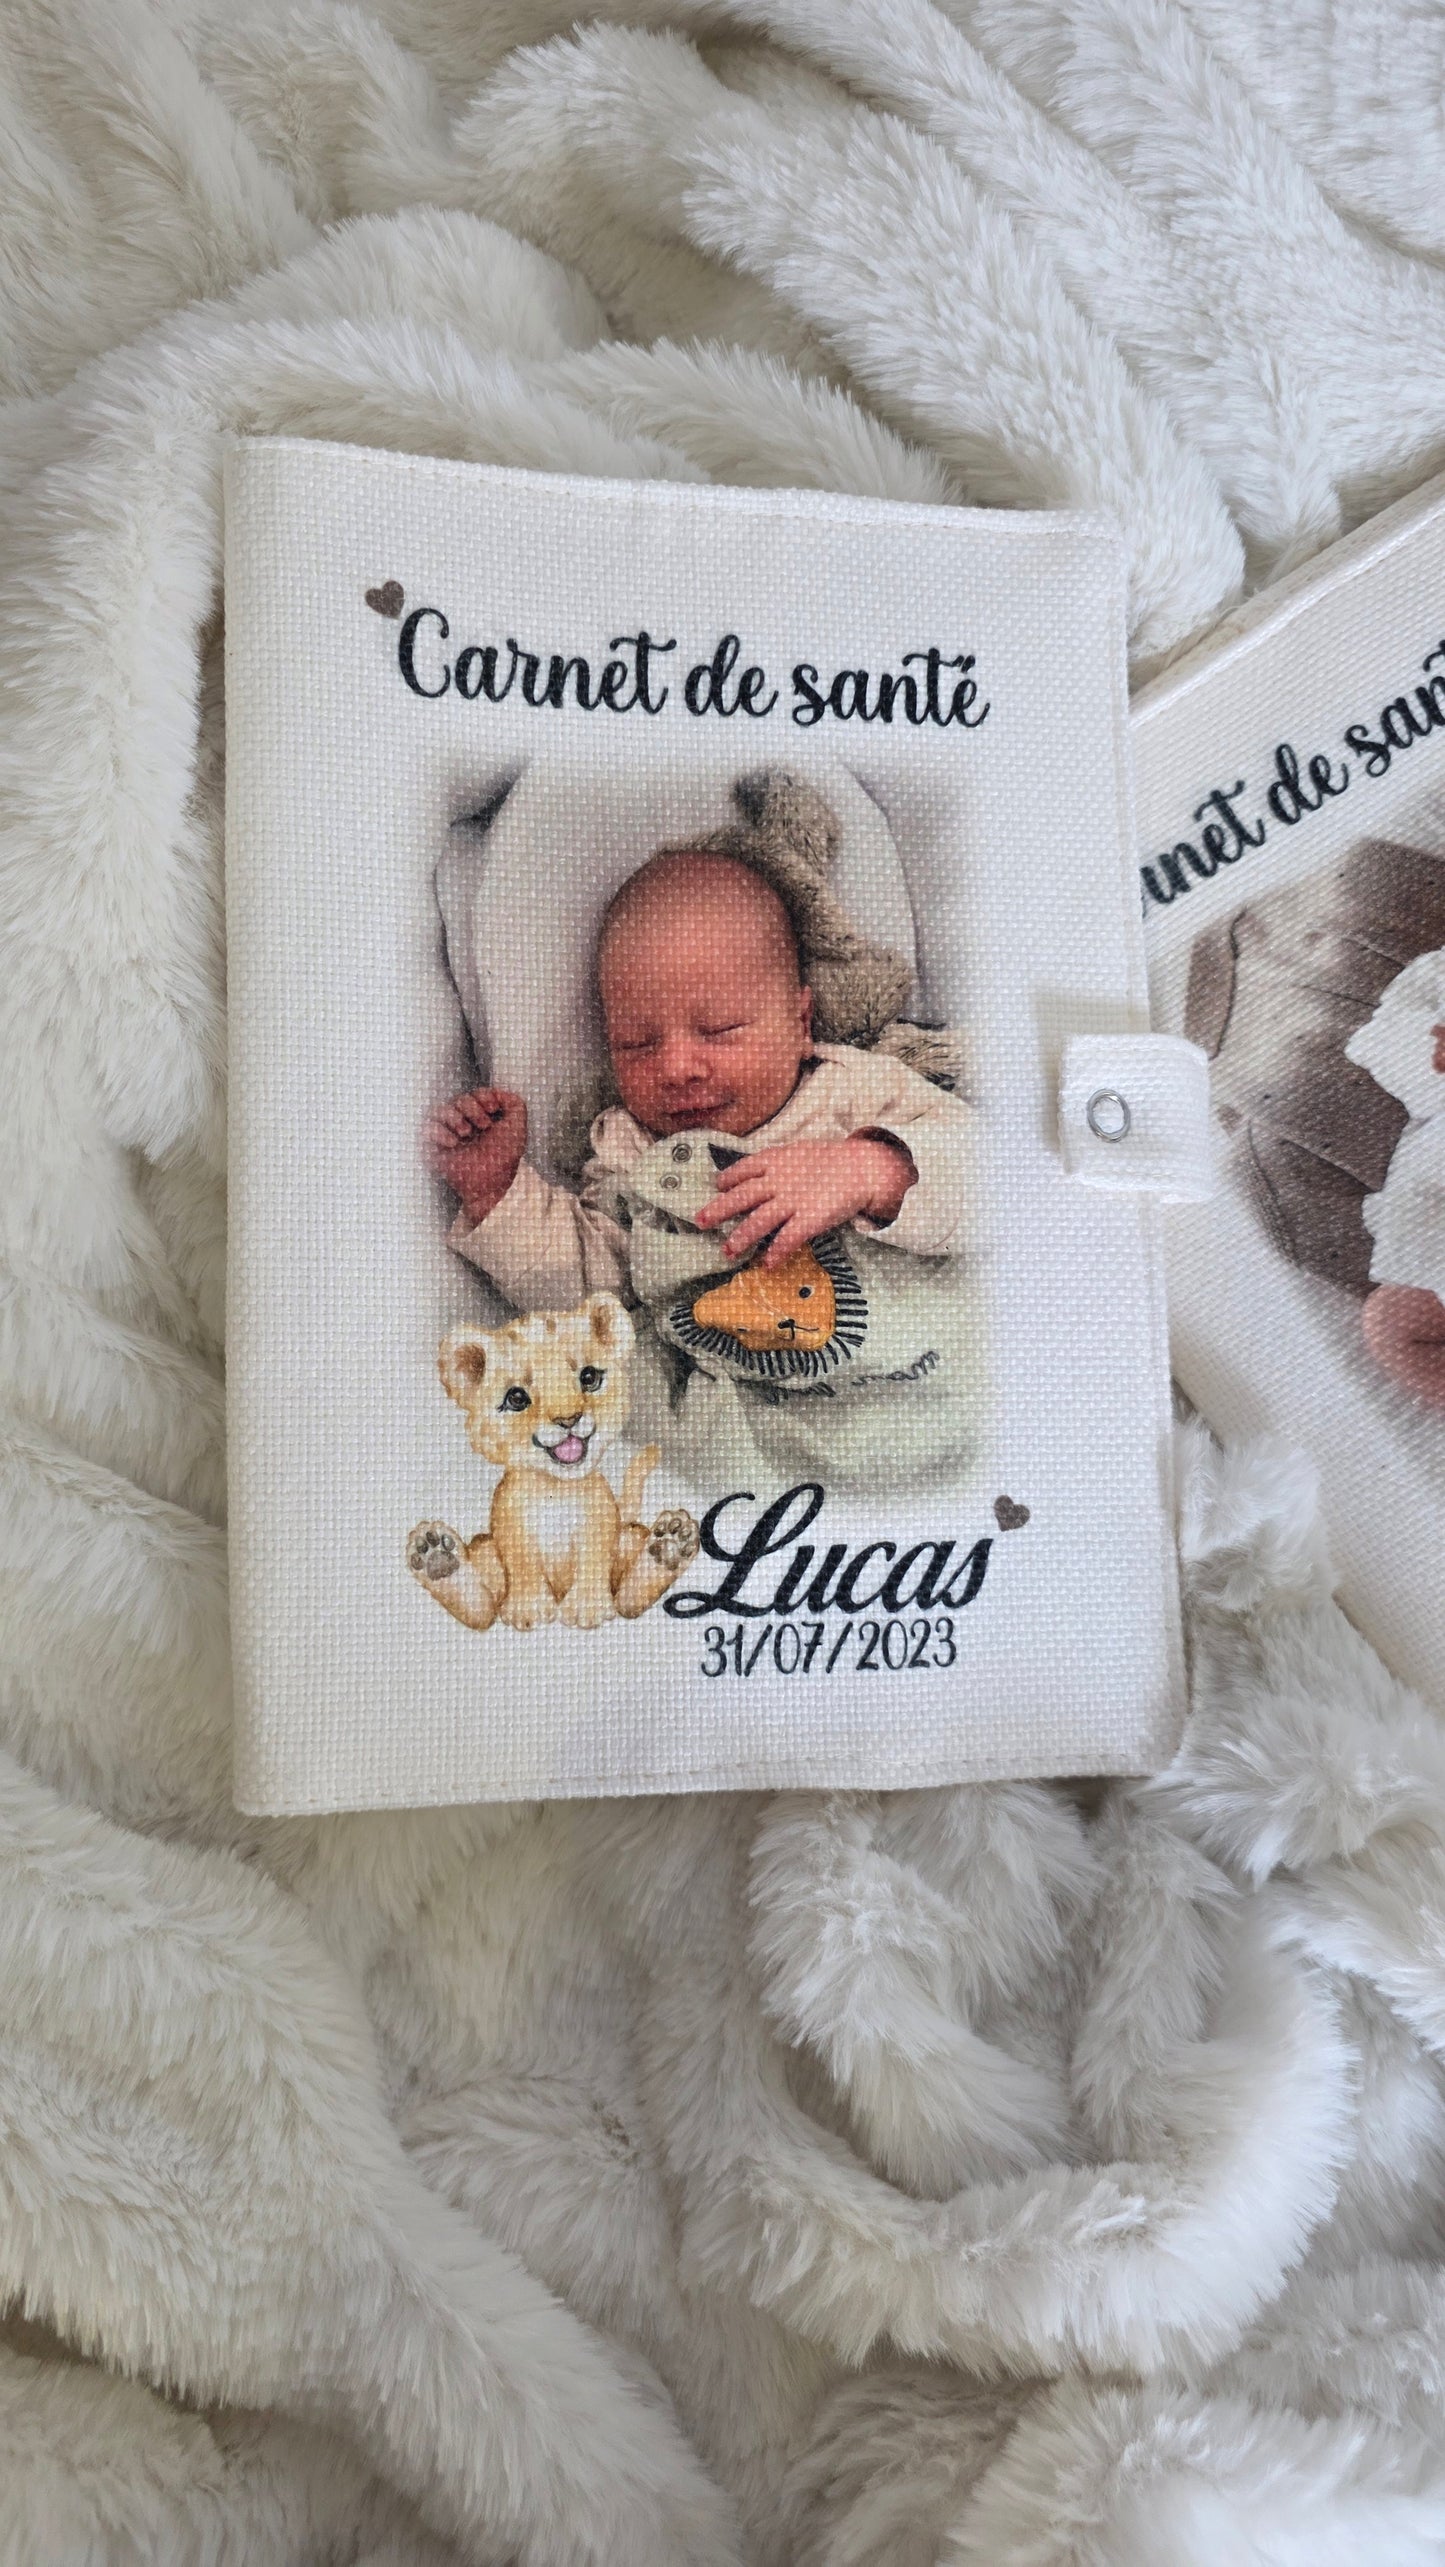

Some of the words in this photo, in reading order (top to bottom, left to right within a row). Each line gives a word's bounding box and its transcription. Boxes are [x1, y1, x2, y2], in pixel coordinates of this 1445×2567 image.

[398, 607, 677, 715] Carnet
[684, 634, 779, 717] de
[791, 647, 990, 728] santé
[1267, 743, 1349, 825] de
[1344, 639, 1445, 778] san
[662, 1482, 994, 1618] Lucas
[700, 1616, 958, 1678] 31/07/2023
